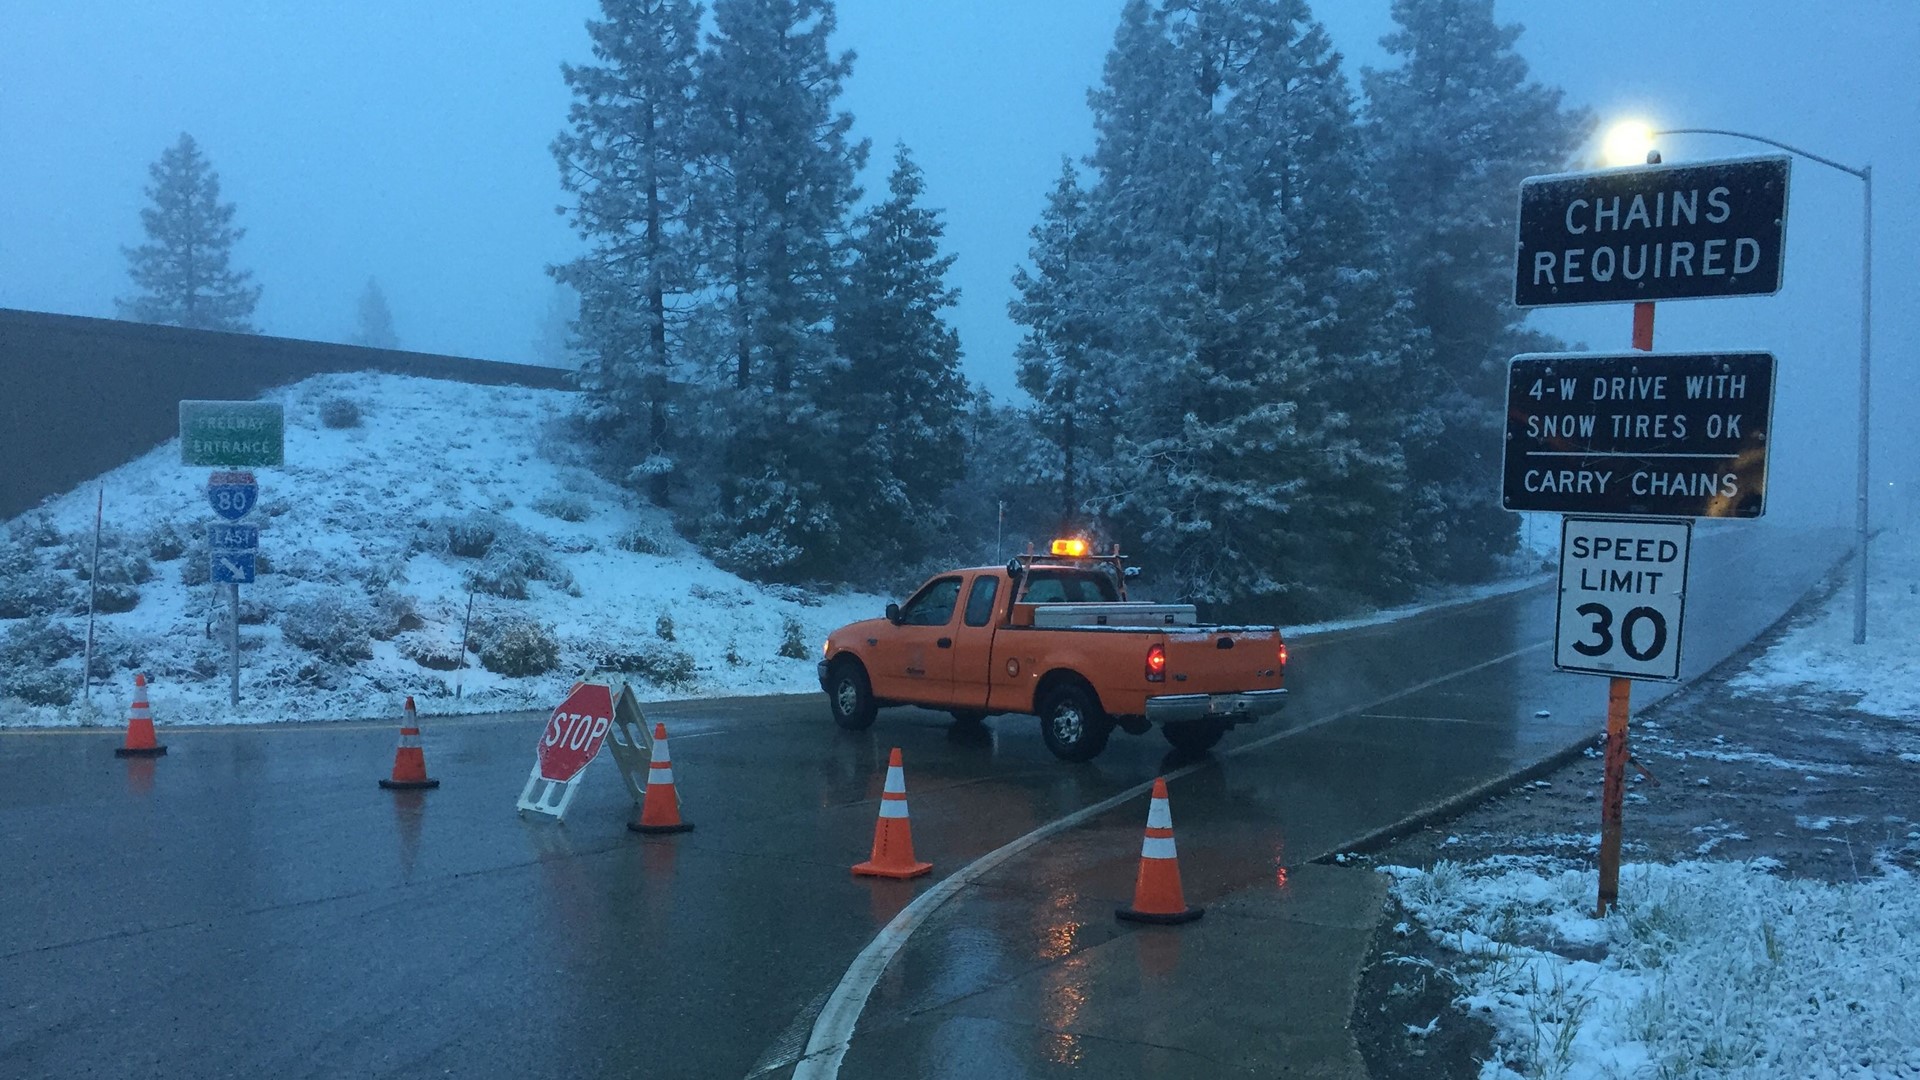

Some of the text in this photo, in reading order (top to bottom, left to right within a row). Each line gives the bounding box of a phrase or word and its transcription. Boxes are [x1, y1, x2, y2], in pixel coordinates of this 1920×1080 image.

[1565, 187, 1731, 235] CHAINS
[1533, 237, 1760, 286] REQUIRED
[1529, 375, 1746, 401] 4-W DRIVE WITH
[1526, 414, 1742, 439] SNOW TIRES OK
[193, 440, 270, 454] ENTRANCE
[1524, 470, 1738, 498] CARRY CHAINS
[218, 491, 246, 510] 80
[1572, 536, 1678, 563] SPEED
[1581, 568, 1663, 594] LIMIT
[1572, 602, 1667, 661] 30
[545, 712, 608, 752] STOP
